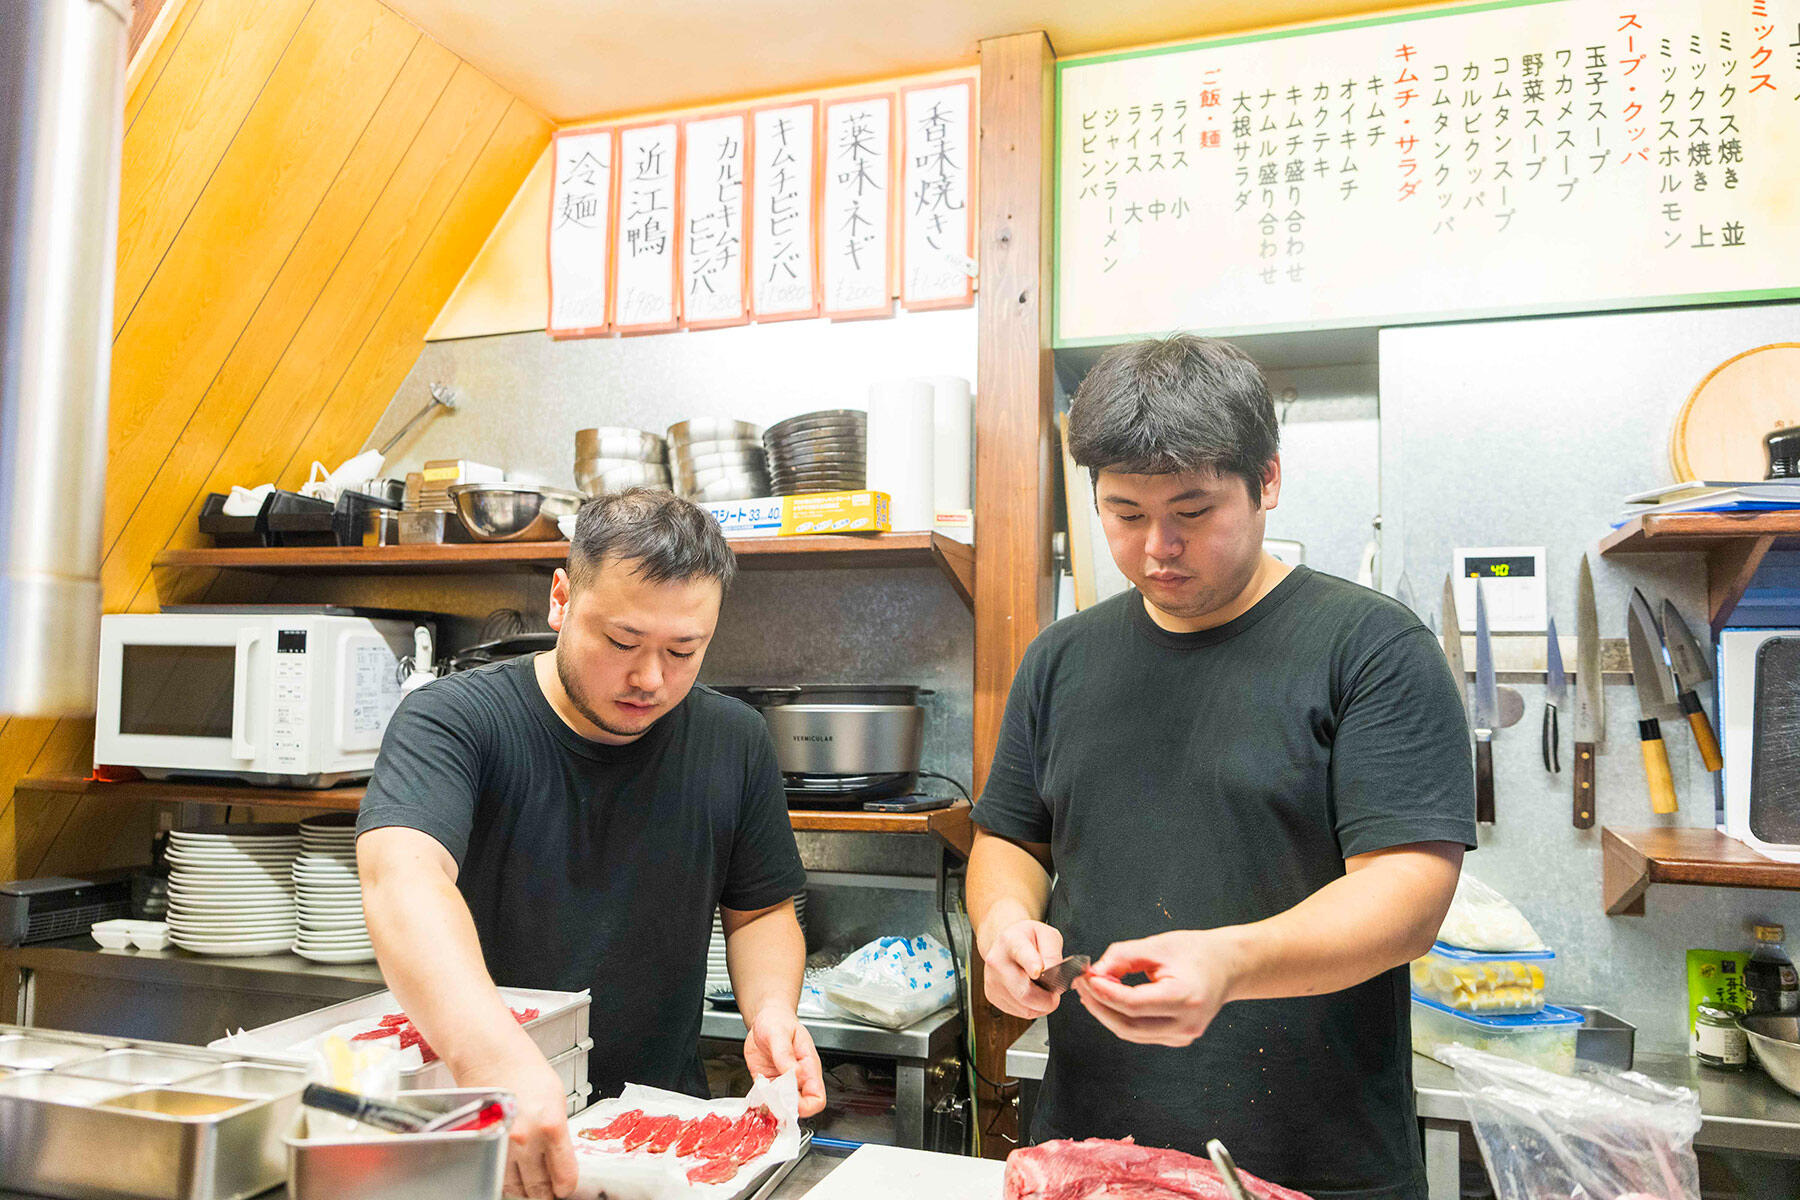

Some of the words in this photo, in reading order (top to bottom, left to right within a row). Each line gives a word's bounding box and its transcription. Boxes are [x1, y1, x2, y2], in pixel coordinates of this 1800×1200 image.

[1124, 104, 1143, 175] ライス
[1147, 102, 1167, 172] ライス
[1171, 99, 1189, 170] ライス
[1231, 89, 1253, 213] 大根サラダ
[1311, 80, 1332, 179] カクテキ
[1338, 77, 1361, 201] オイキムチ
[1365, 74, 1387, 148] キムチ
[1392, 42, 1423, 203] キムチ・サラダ
[1431, 63, 1455, 234] コムタンクッパ
[1460, 60, 1485, 210] カルビクッパ
[1491, 55, 1516, 232] コムタンスープ
[1520, 51, 1548, 182] 野菜スープ
[1553, 47, 1580, 203] ワカメスープ
[1583, 44, 1612, 175] 玉子スープ
[1616, 13, 1651, 165] スープ・クッパ
[1656, 37, 1683, 249] ミックスホルモン
[1686, 34, 1714, 193] ミックス焼き
[1717, 30, 1745, 191] ミックス焼き
[555, 150, 609, 230] 冷麺
[626, 141, 668, 258] 近江鴨
[768, 119, 800, 283] キムチビビンバ
[837, 112, 881, 271] 薬味ネギ
[914, 101, 965, 250] 香味焼き
[1079, 109, 1099, 201] ビビンバ
[1103, 107, 1120, 273] ジャンラーメン
[1124, 201, 1144, 225] 大
[1147, 198, 1166, 222] 中
[1170, 196, 1191, 220] 小
[1257, 87, 1280, 284] ナムル盛り合わせ
[1283, 84, 1306, 284] キムチ盛り合わせ
[1690, 223, 1716, 249] 上
[1720, 219, 1747, 249] 並
[1490, 564, 1510, 576] 40
